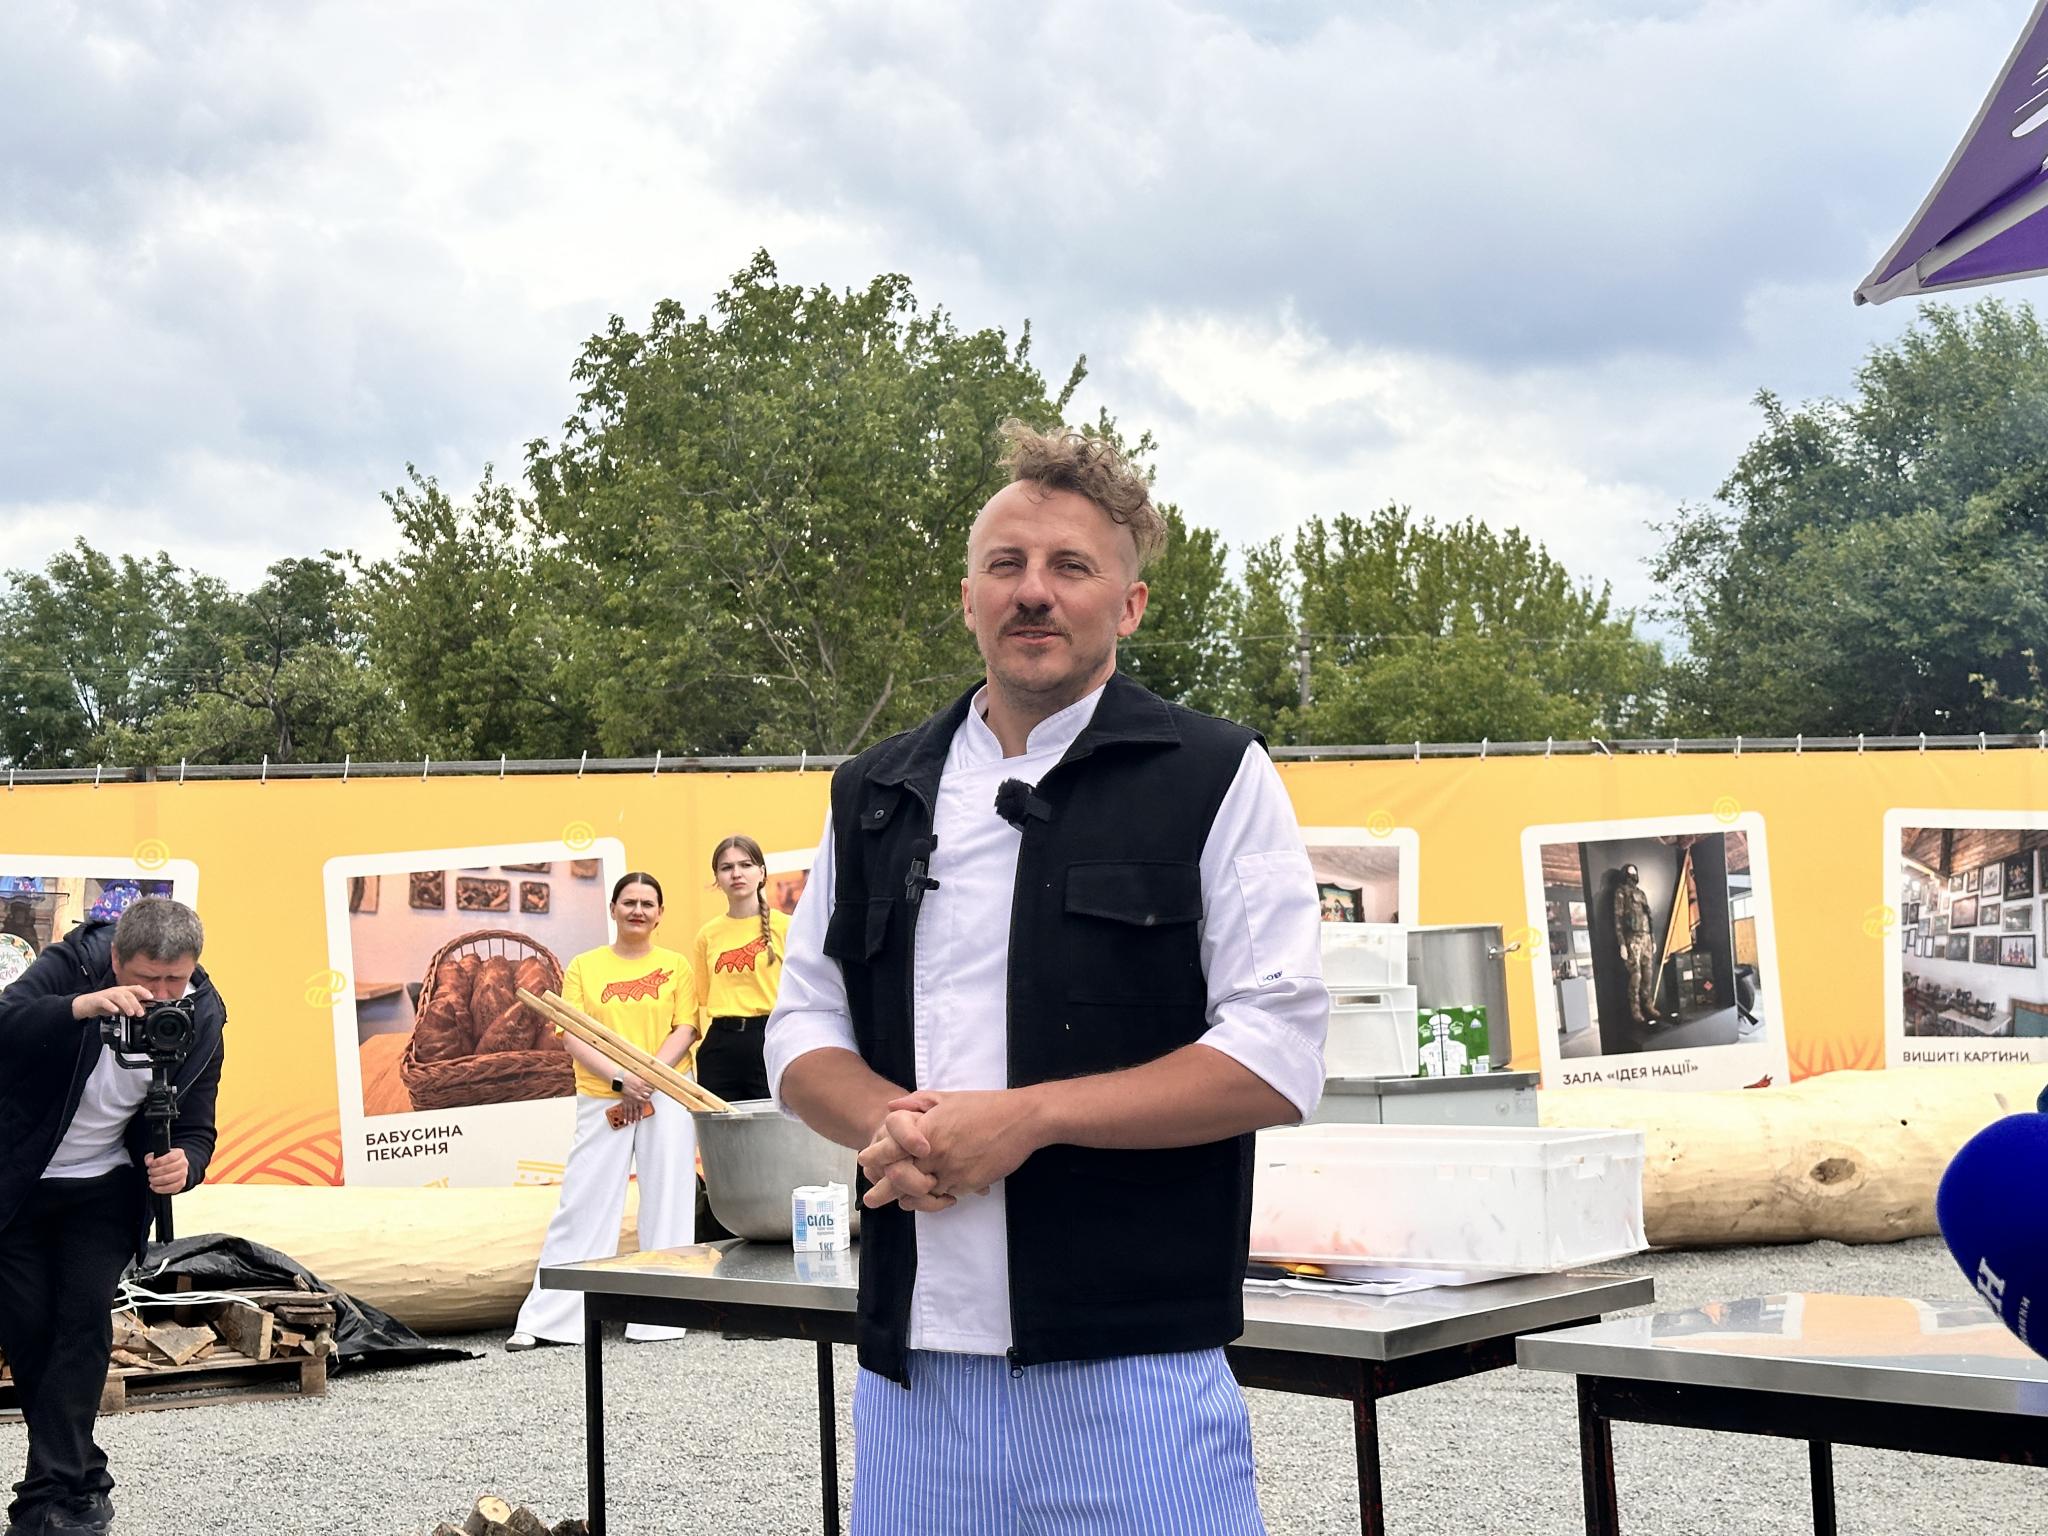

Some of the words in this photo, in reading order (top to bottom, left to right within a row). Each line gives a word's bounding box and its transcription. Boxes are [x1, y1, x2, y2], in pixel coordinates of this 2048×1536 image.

[1903, 1051, 1959, 1062] ВИШИТІ
[1964, 1051, 2030, 1063] КАРТИНИ
[1562, 1072, 1602, 1085] ЗАЛА
[1607, 1066, 1648, 1083] «ІДЕЯ
[1652, 1059, 1699, 1078] НАЦІЇ»
[365, 1124, 463, 1146] БАБУСИНА
[366, 1141, 449, 1162] ПЕКАРНЯ
